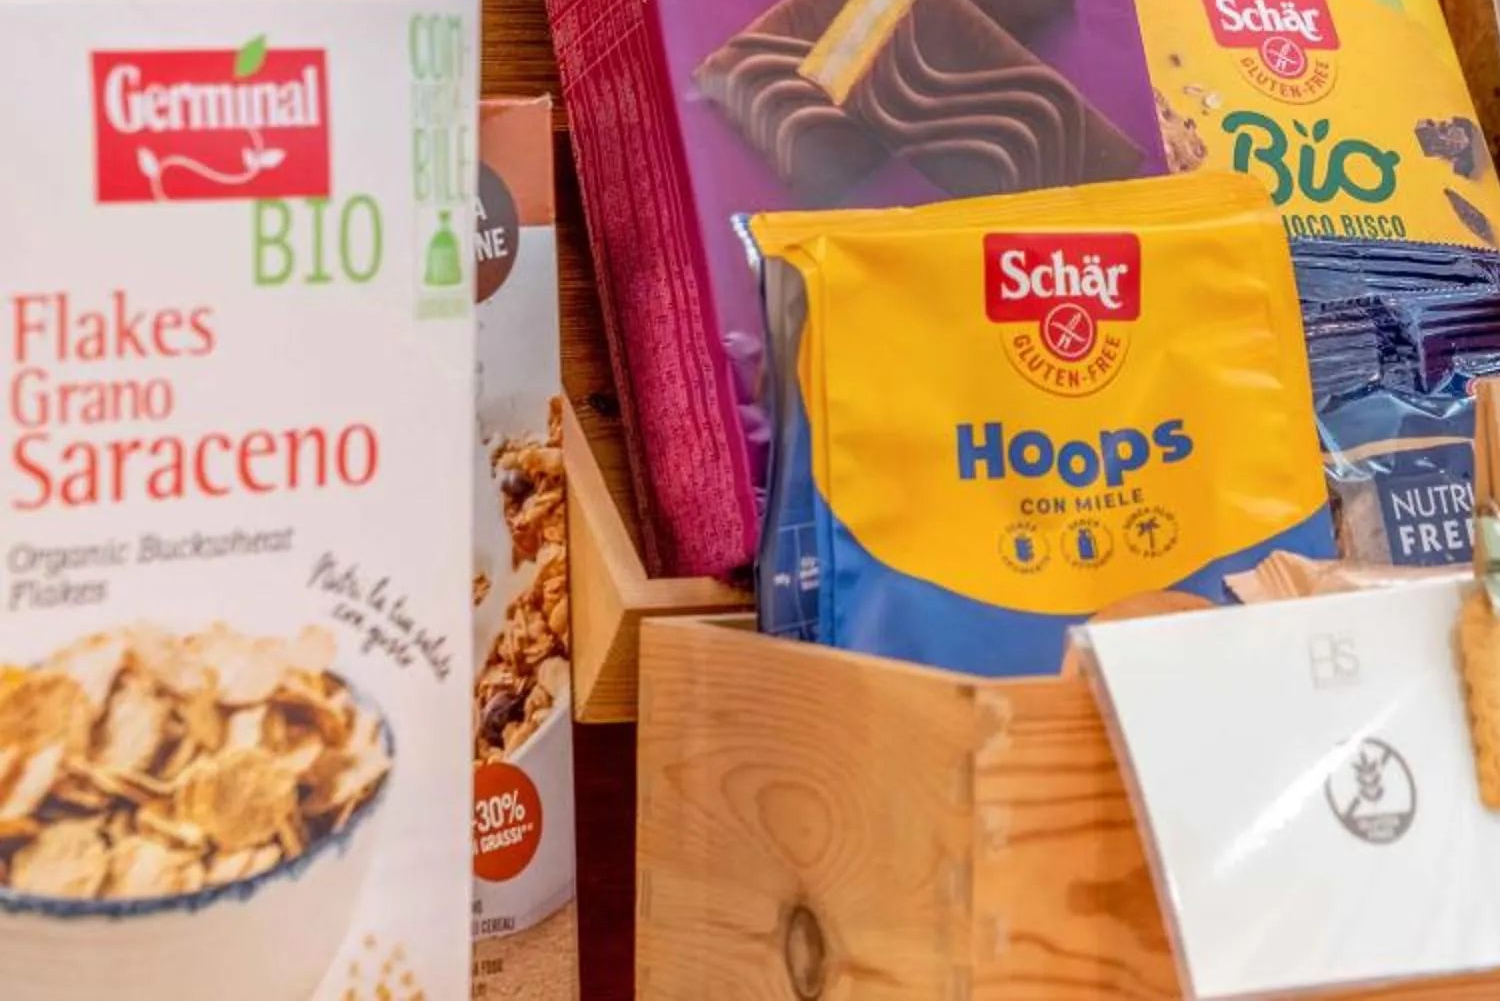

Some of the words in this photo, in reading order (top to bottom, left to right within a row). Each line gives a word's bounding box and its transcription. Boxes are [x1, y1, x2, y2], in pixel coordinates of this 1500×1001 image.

[104, 64, 321, 134] Germinal
[1239, 55, 1331, 98] GLUTEN-FREE
[252, 193, 384, 287] BIO
[999, 249, 1129, 310] Schär
[12, 289, 217, 364] Flakes
[1013, 333, 1122, 389] GLUTEN-FREE
[9, 366, 175, 429] Grano
[10, 423, 380, 512] Saraceno
[1019, 496, 1066, 516] CON
[1075, 487, 1144, 513] MIELE
[1391, 481, 1474, 520] NUTRI
[5, 541, 130, 575] Organic
[137, 526, 295, 564] Buckwheat
[7, 580, 109, 613] Flakes
